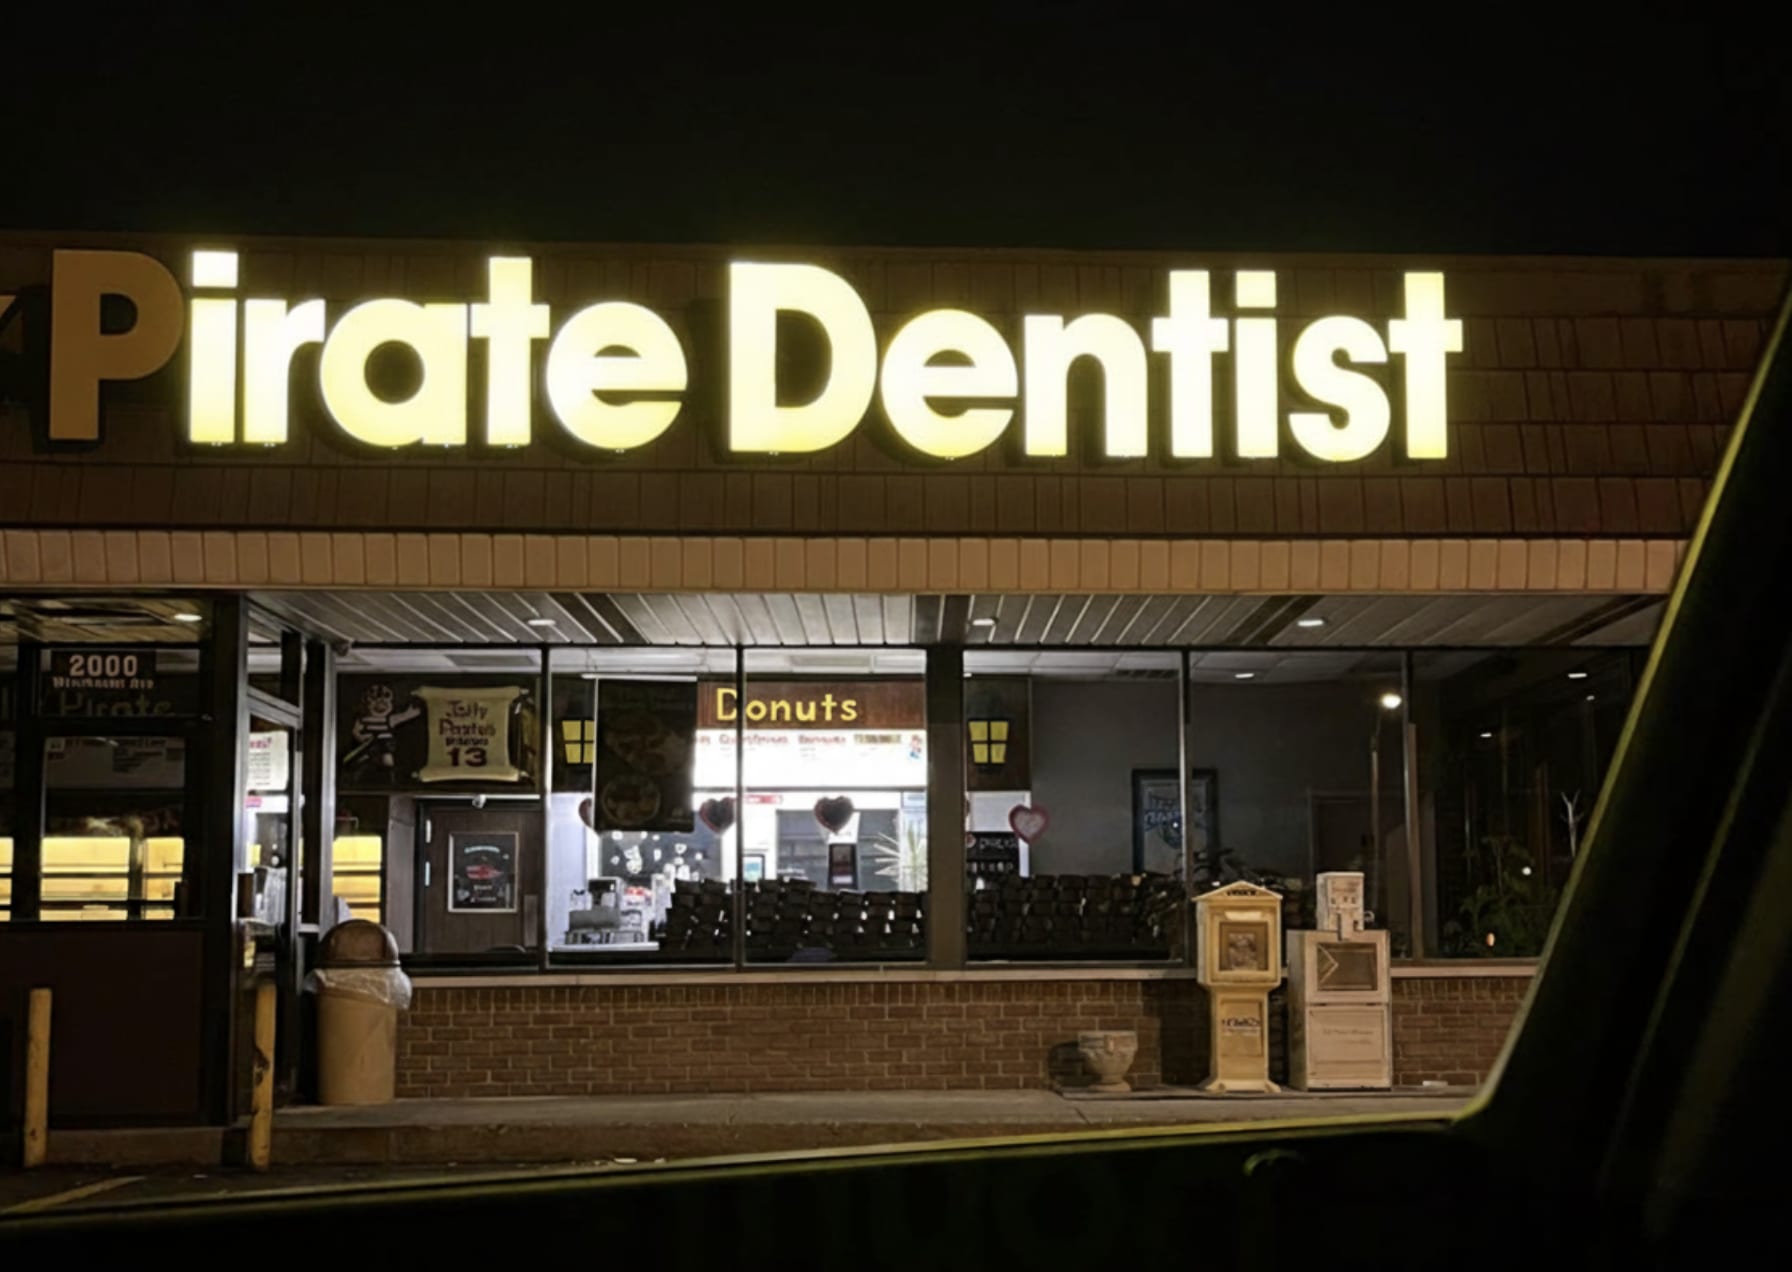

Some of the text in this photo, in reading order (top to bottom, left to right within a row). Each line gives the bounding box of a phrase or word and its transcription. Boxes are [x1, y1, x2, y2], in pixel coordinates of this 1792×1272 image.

[50, 249, 1462, 463] Pirate Dentist
[69, 654, 138, 677] 2000
[60, 690, 172, 717] Pirate
[716, 687, 858, 721] Donuts
[447, 747, 487, 767] 13
